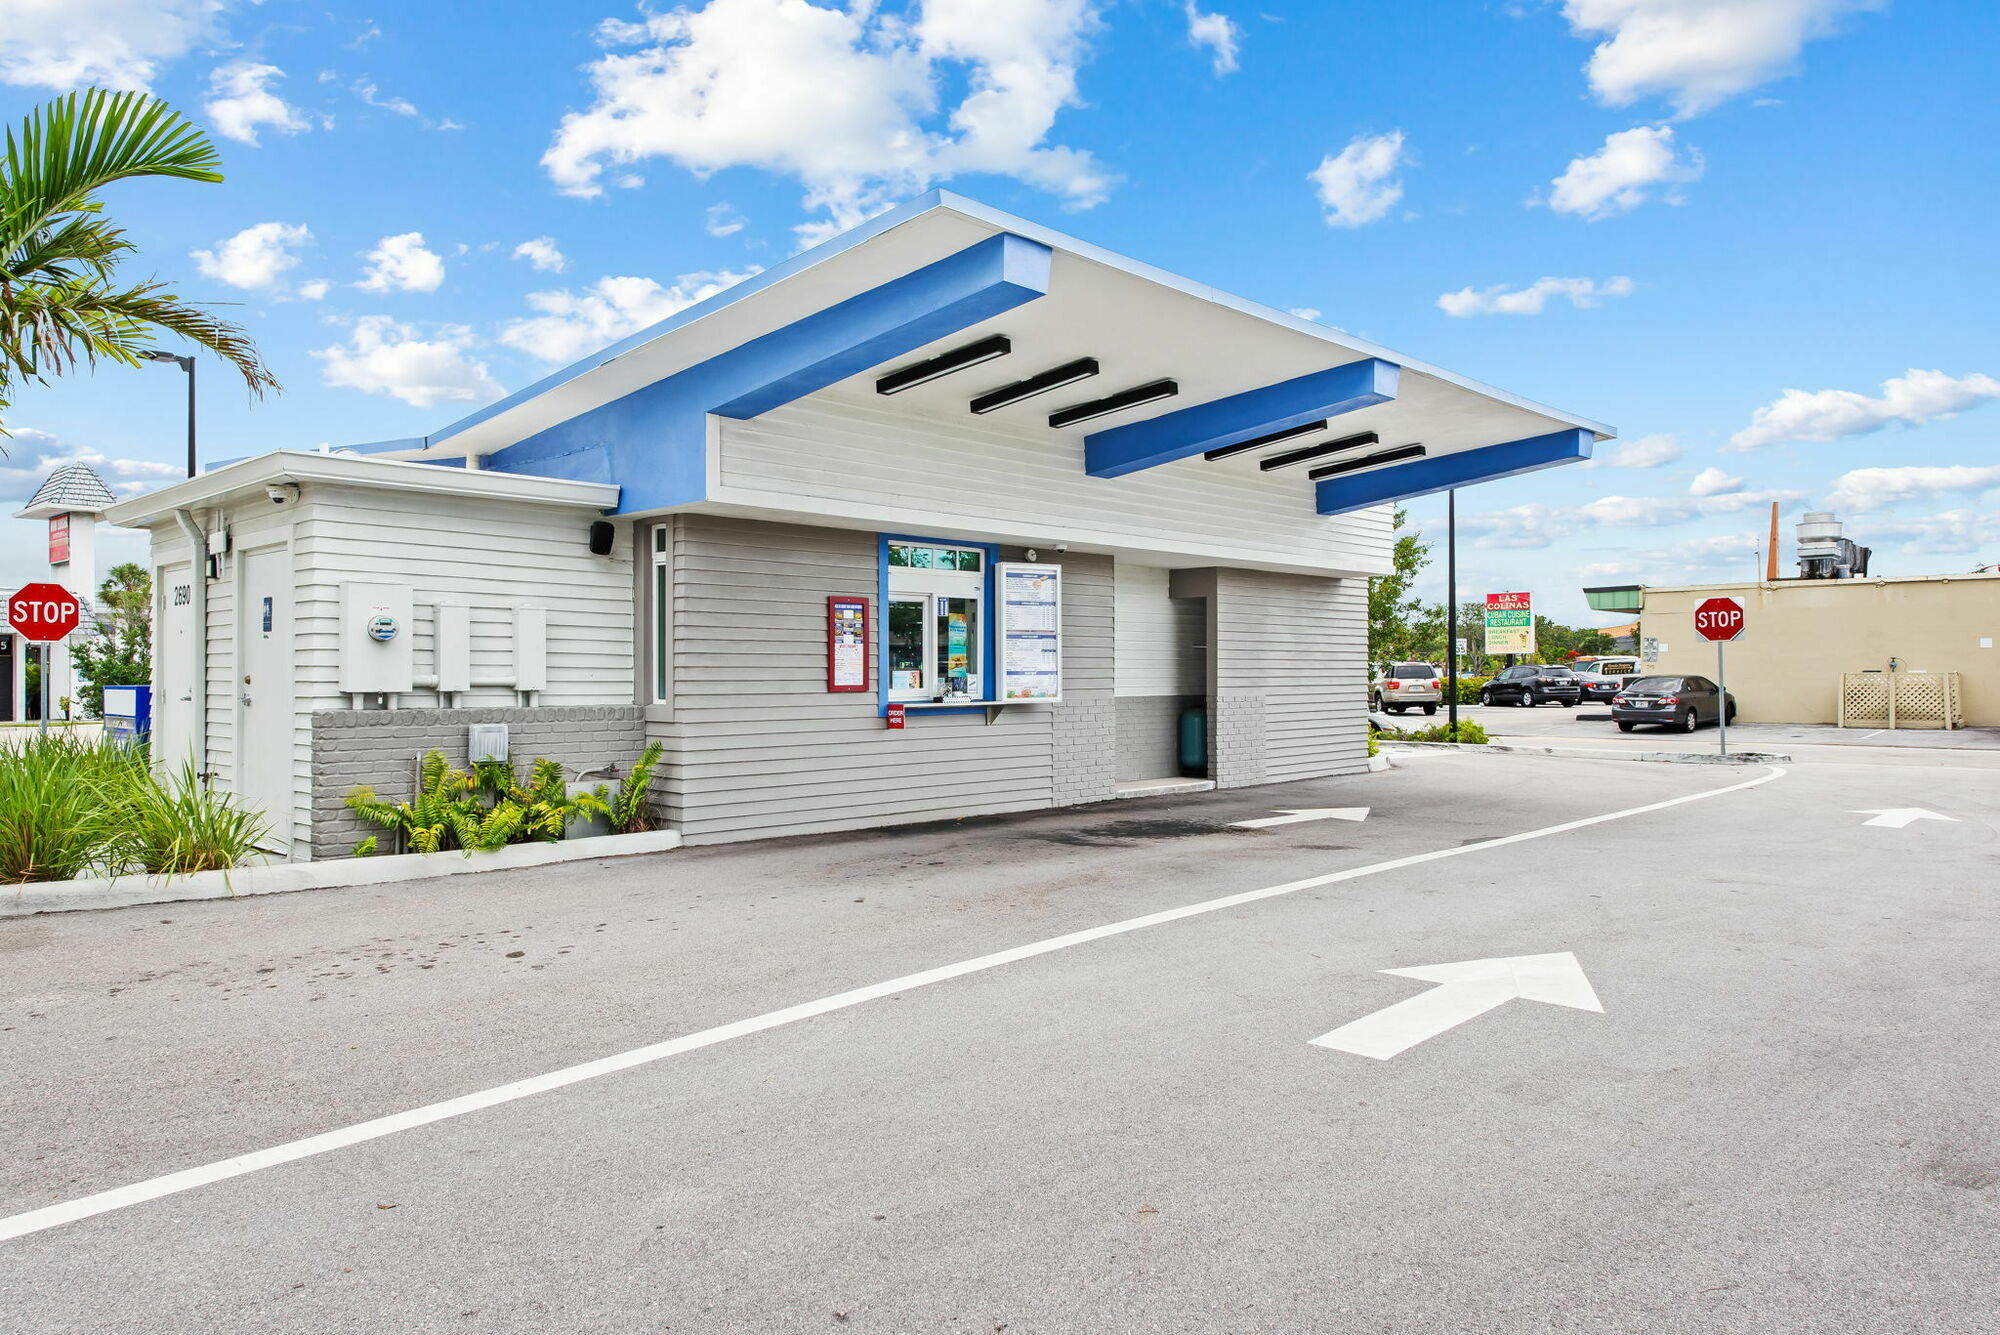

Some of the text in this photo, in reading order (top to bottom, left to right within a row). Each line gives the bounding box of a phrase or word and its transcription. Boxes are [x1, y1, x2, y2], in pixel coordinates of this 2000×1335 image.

[174, 585, 191, 606] 2690
[12, 601, 75, 623] STOP
[1487, 601, 1529, 610] COLINAS
[1487, 610, 1530, 619] CUBAN CUISINE
[1697, 610, 1741, 628] STOP
[1490, 618, 1527, 626] RESTAURANT
